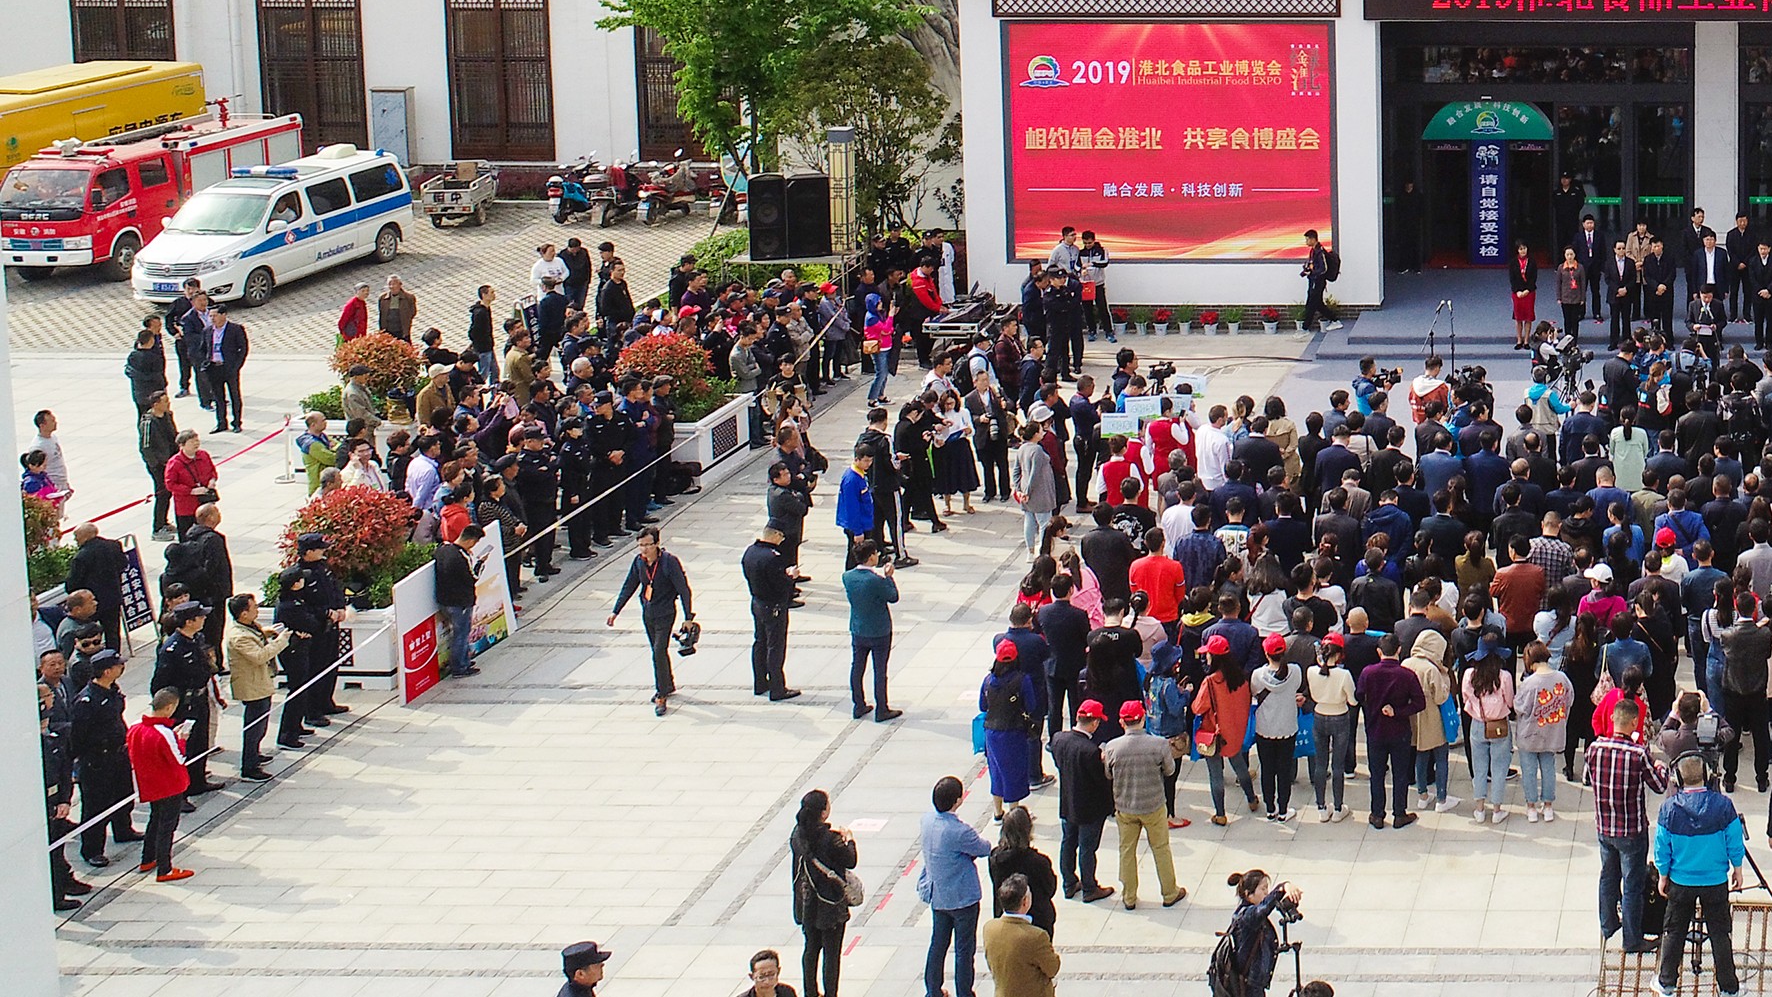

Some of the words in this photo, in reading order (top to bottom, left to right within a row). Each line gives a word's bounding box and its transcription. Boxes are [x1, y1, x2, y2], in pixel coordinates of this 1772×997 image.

[1071, 60, 1131, 84] 2019
[1138, 59, 1282, 76] 淮北食品工业博览会
[1138, 76, 1175, 85] Huaibei
[1177, 76, 1222, 85] Industrial
[1225, 76, 1249, 85] Food
[1253, 76, 1282, 85] EXPO
[1025, 127, 1163, 151] 相约绿金淮北
[1183, 127, 1321, 151] 共享食博盛会
[1478, 174, 1499, 257] 请自觉接受安检
[316, 242, 354, 261] Ambulance
